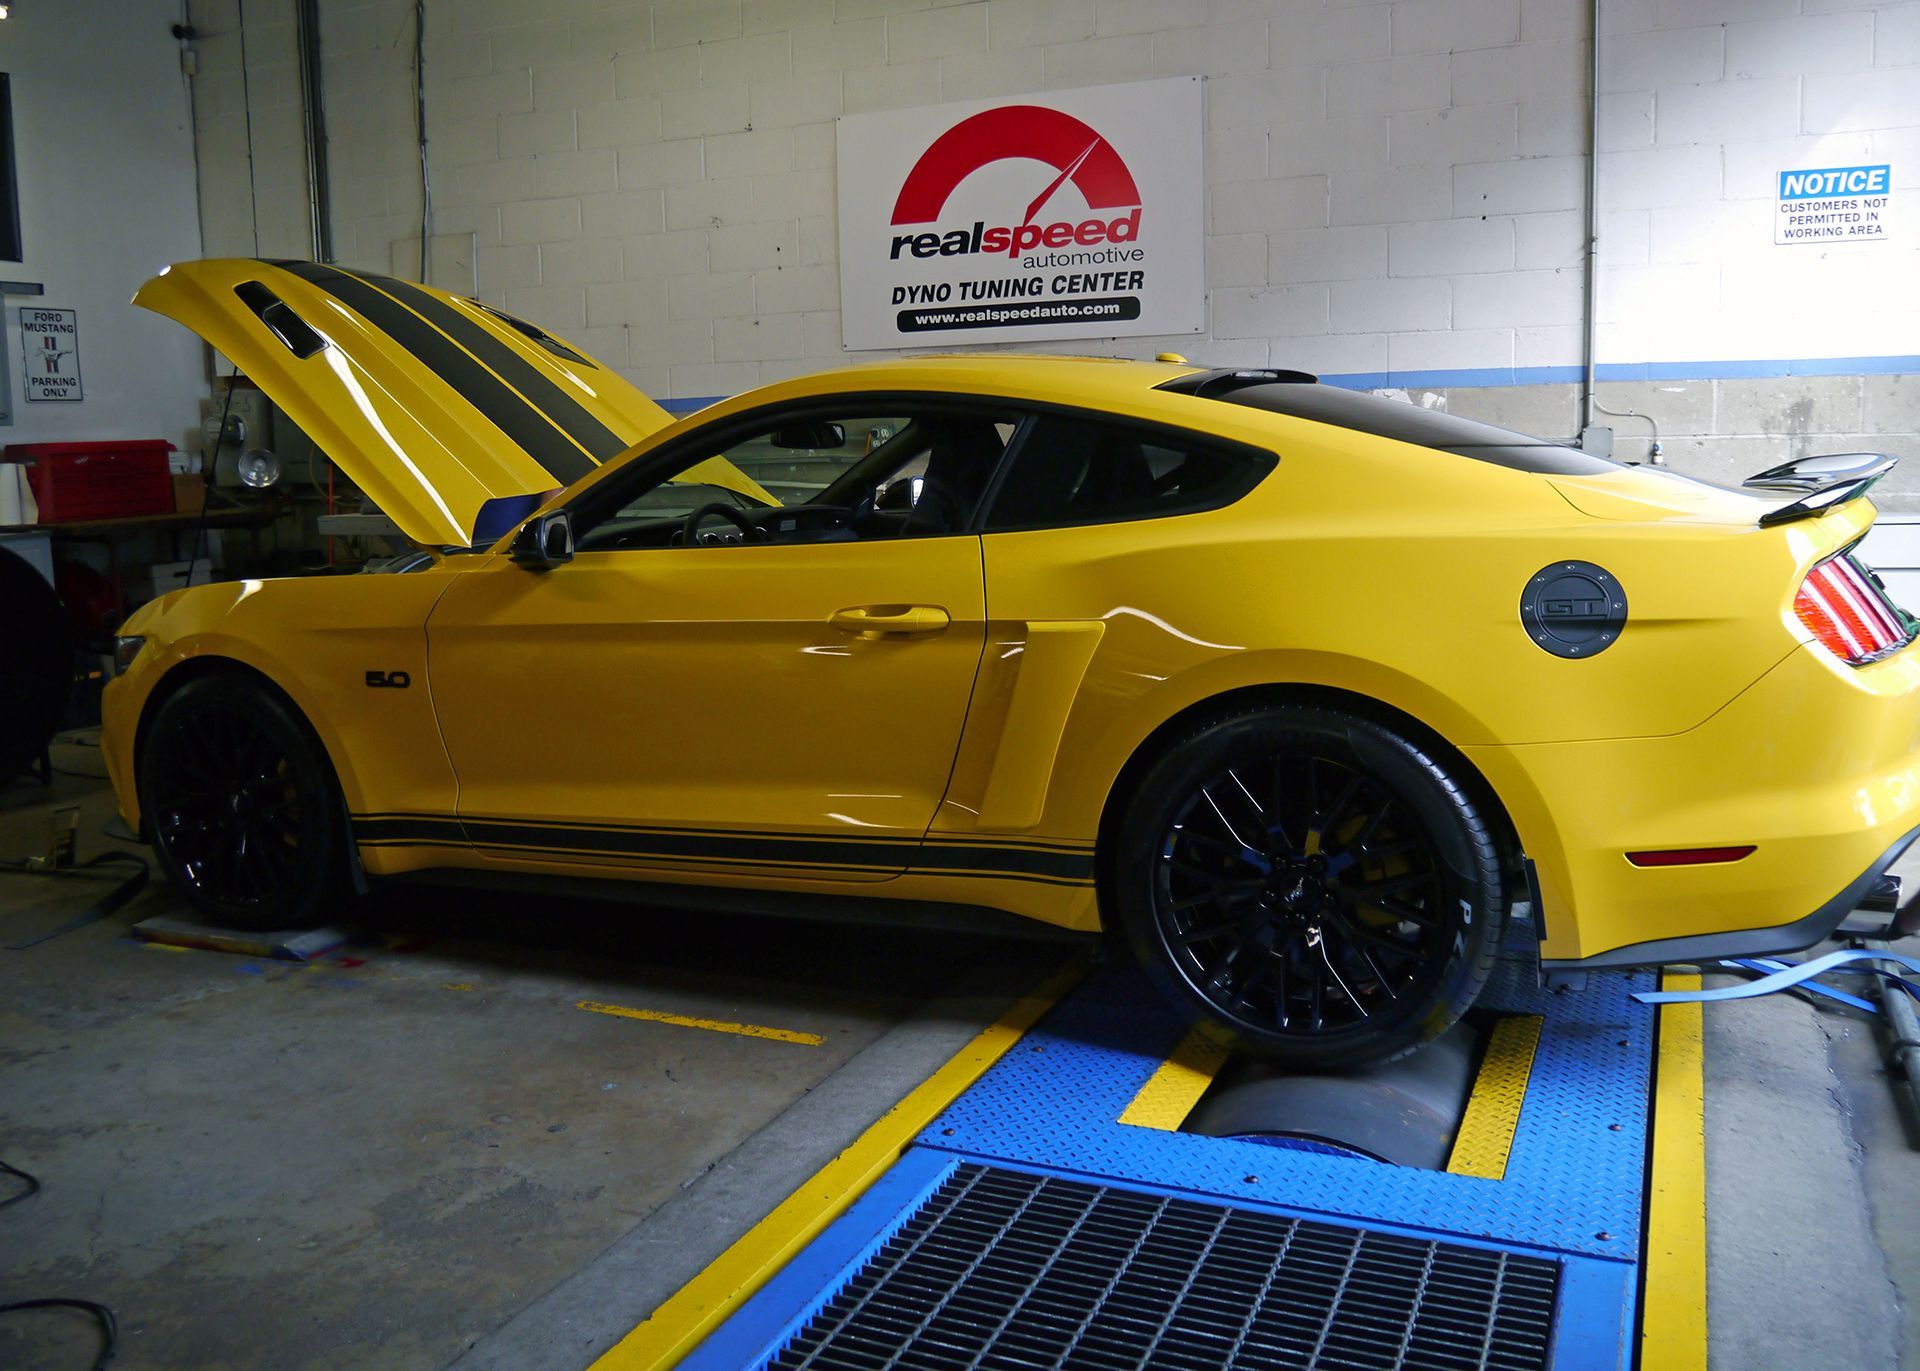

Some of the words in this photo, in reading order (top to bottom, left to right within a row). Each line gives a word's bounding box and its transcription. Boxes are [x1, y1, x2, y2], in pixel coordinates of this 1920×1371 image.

[1783, 169, 1887, 196] NOTICE
[1780, 199, 1858, 213] CUSTOMERS
[1863, 198, 1888, 209] NOT
[1789, 212, 1861, 226] PERMITTED
[1866, 212, 1879, 221] IN
[889, 208, 1143, 260] realspeed
[1784, 226, 1843, 239] WORKING
[1848, 225, 1883, 235] AREA
[1023, 248, 1145, 269] automotive
[891, 282, 952, 305] DYNO
[958, 276, 1044, 301] TUNING
[1051, 270, 1145, 295] CENTER
[34, 312, 62, 322] FORD
[915, 304, 1120, 326] www.realspeedauto.com
[24, 323, 74, 334] MUSTANG
[31, 377, 77, 387] PARKING
[43, 388, 68, 397] ONLY
[1541, 598, 1608, 618] GT
[365, 670, 411, 689] 5.0
